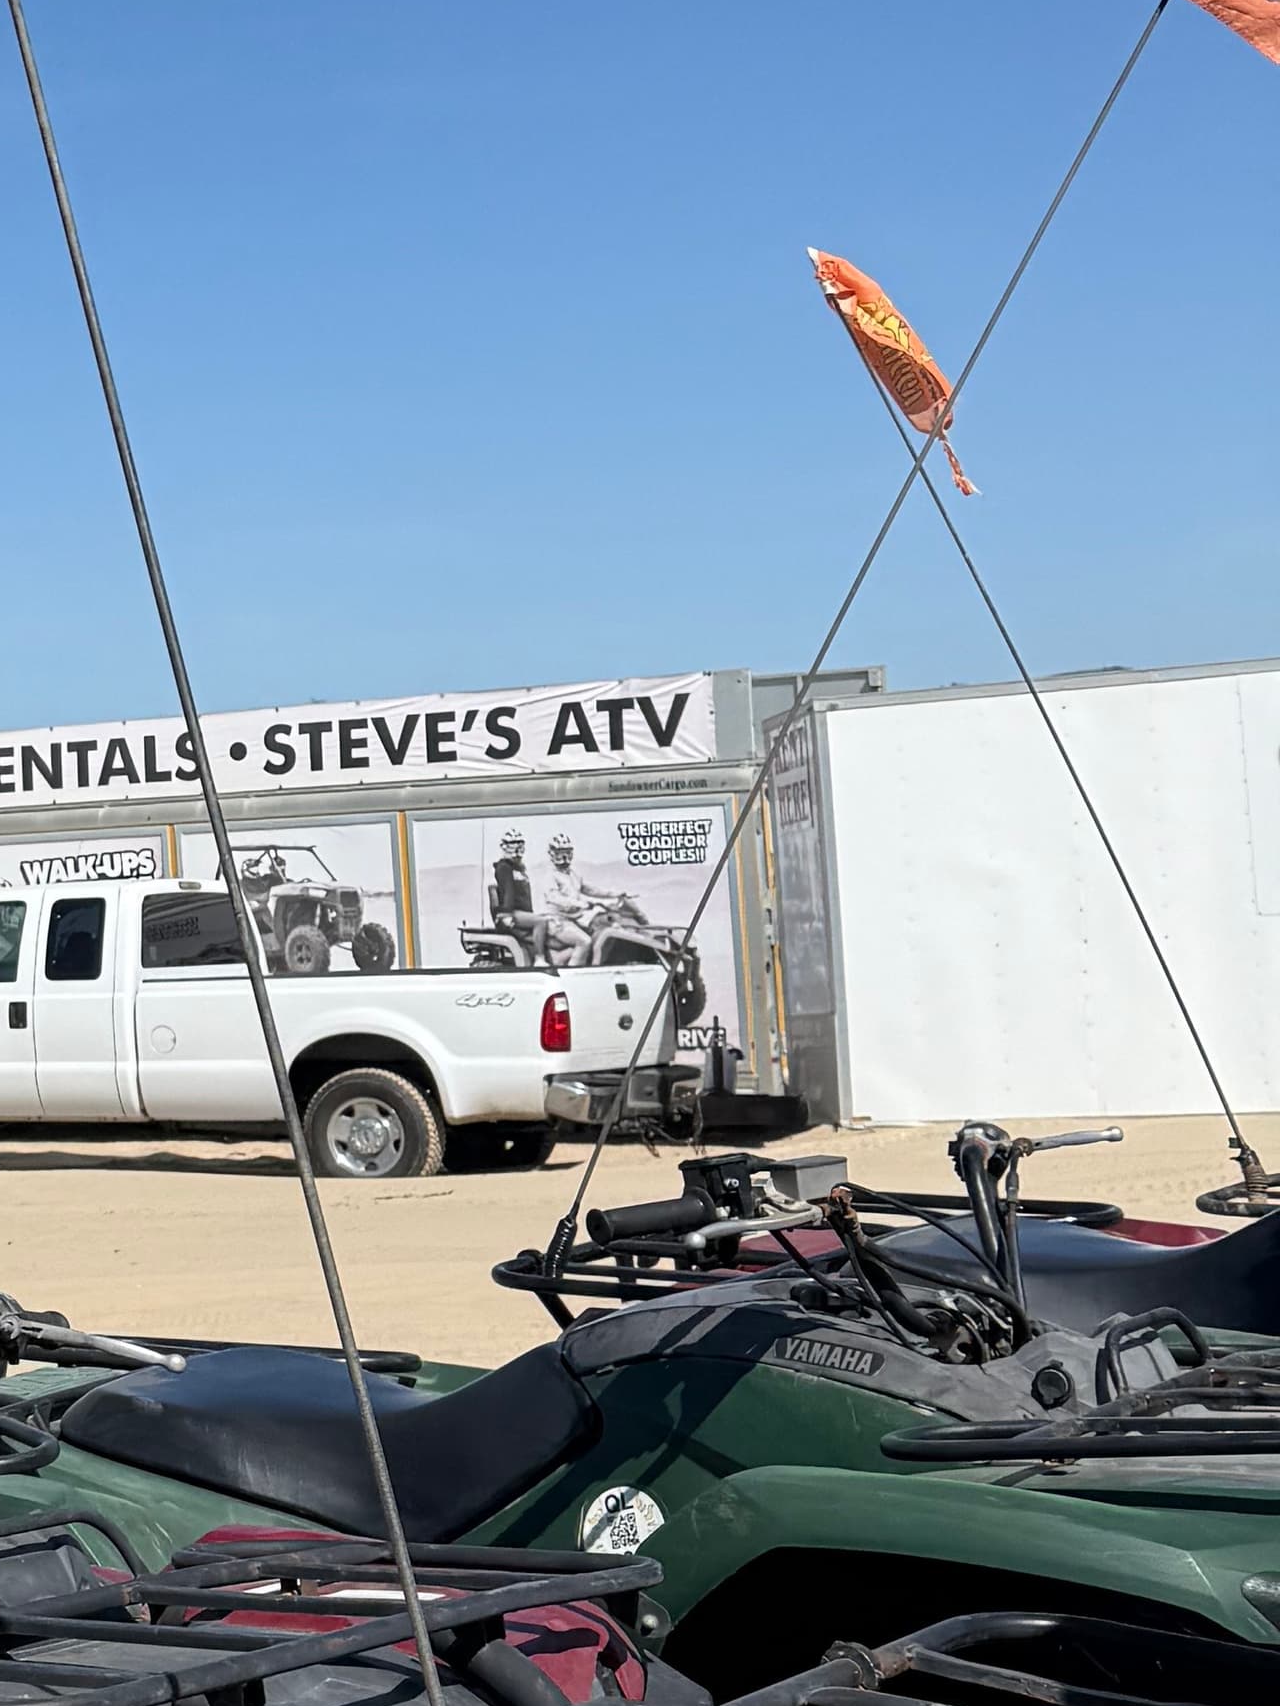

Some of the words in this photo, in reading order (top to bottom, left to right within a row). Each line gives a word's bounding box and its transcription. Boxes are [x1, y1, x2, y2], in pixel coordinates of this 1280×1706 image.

[263, 705, 521, 775] STEVE'S
[547, 693, 690, 756] ATV
[618, 823, 648, 839] THE
[650, 819, 712, 838] PERFECT
[625, 834, 673, 851] QUAD
[675, 833, 708, 849] FOR
[21, 847, 156, 885] WALK-UPS
[783, 1338, 874, 1375] YAMAHA
[605, 1493, 634, 1514] QL
